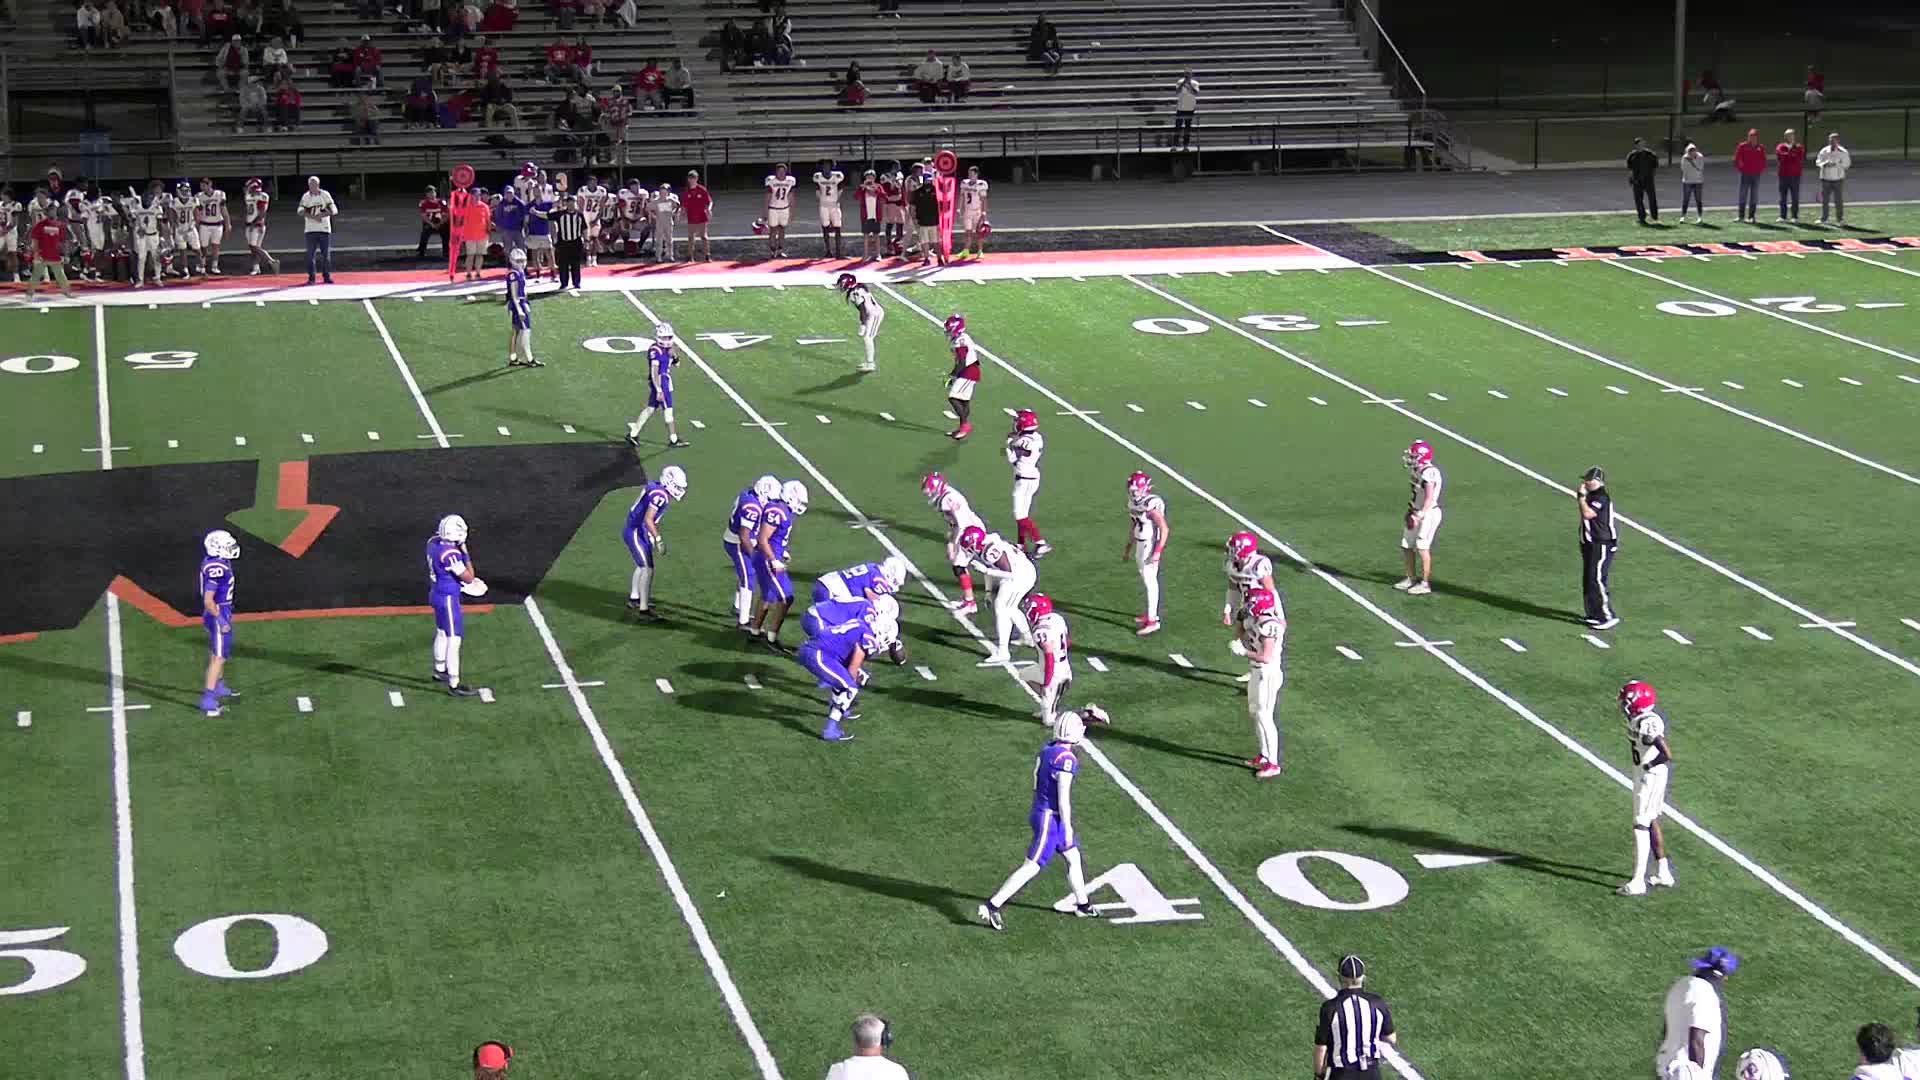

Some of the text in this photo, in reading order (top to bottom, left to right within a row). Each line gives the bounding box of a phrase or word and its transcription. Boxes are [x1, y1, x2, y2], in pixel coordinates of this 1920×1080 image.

[1656, 296, 1846, 317] 20
[1132, 314, 1321, 332] 30
[0, 351, 199, 373] 50
[652, 495, 666, 507] 47
[745, 508, 759, 520] 72
[767, 512, 780, 525] 54
[208, 567, 224, 578] 20
[1063, 759, 1073, 771] 8
[1053, 850, 1409, 923] 40
[0, 913, 328, 996] 50
